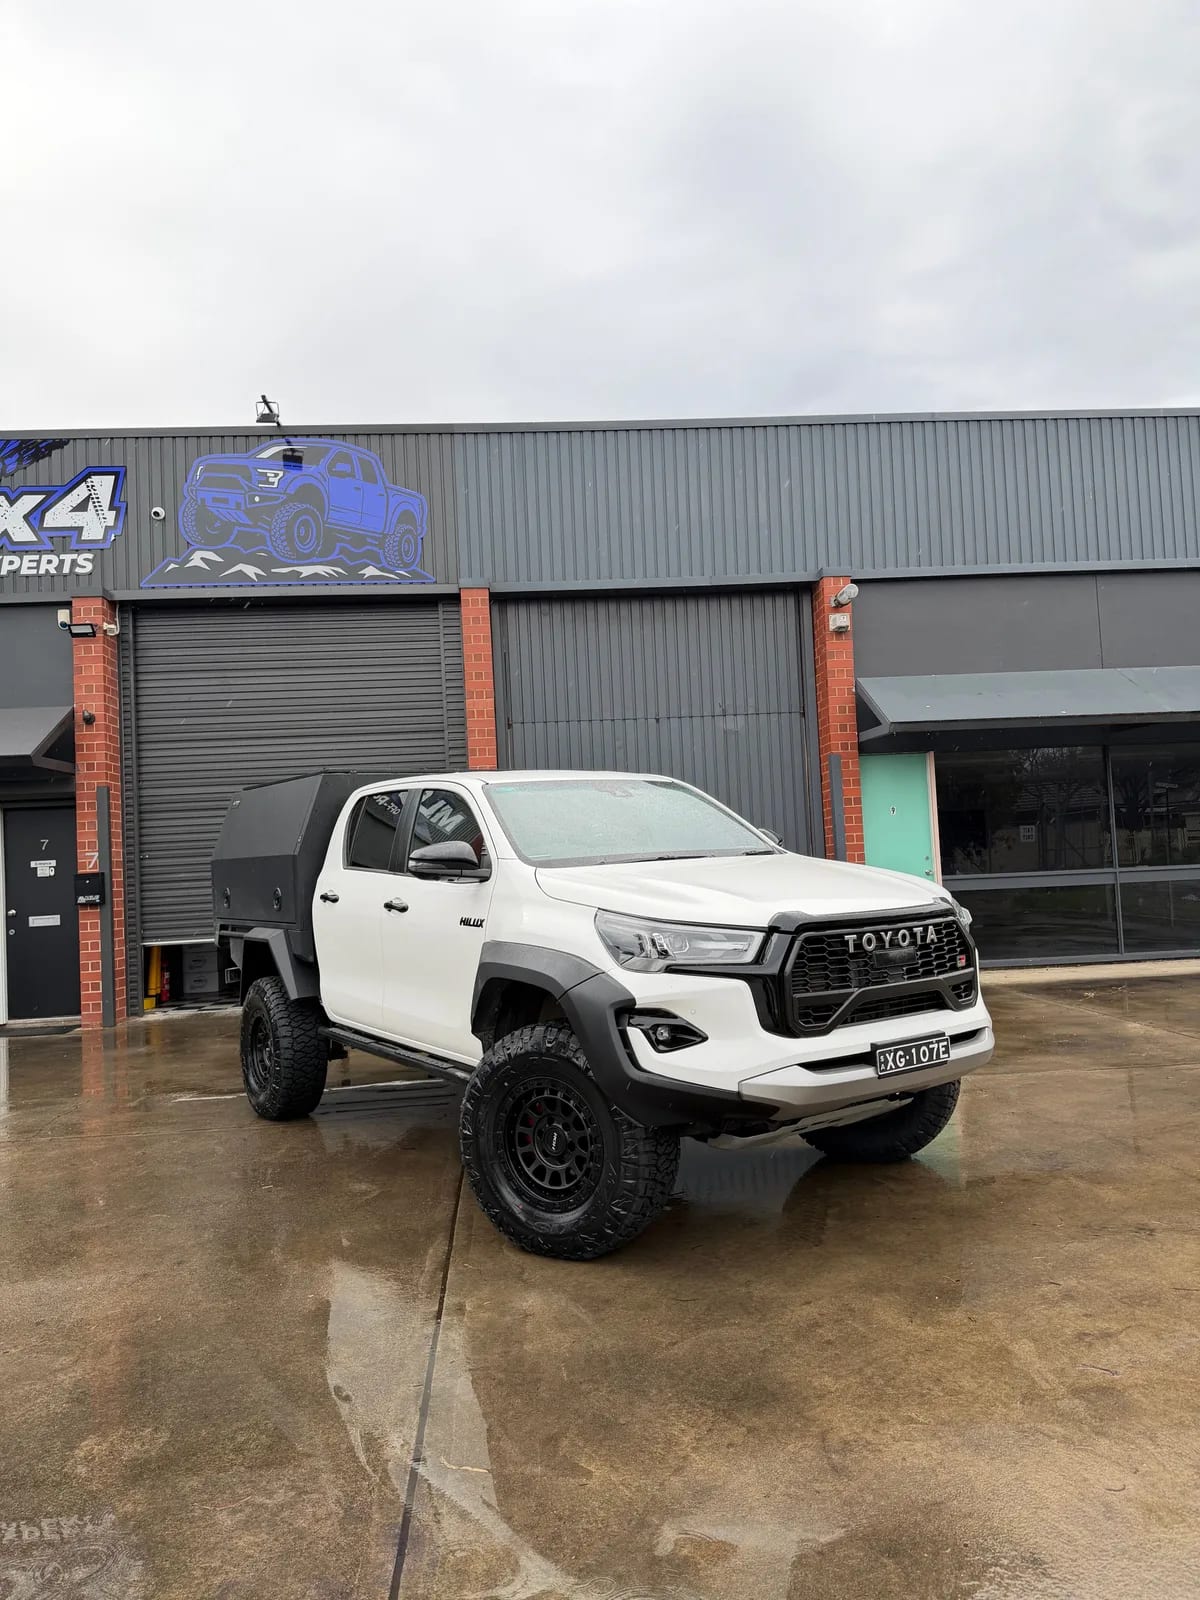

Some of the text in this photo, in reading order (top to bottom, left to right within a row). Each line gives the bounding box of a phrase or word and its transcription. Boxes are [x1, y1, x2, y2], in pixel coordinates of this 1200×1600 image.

[0, 554, 94, 575] PERTS
[40, 839, 49, 851] 7
[85, 851, 99, 869] 7
[459, 917, 485, 928] HILUX
[845, 926, 937, 953] TOYOTA
